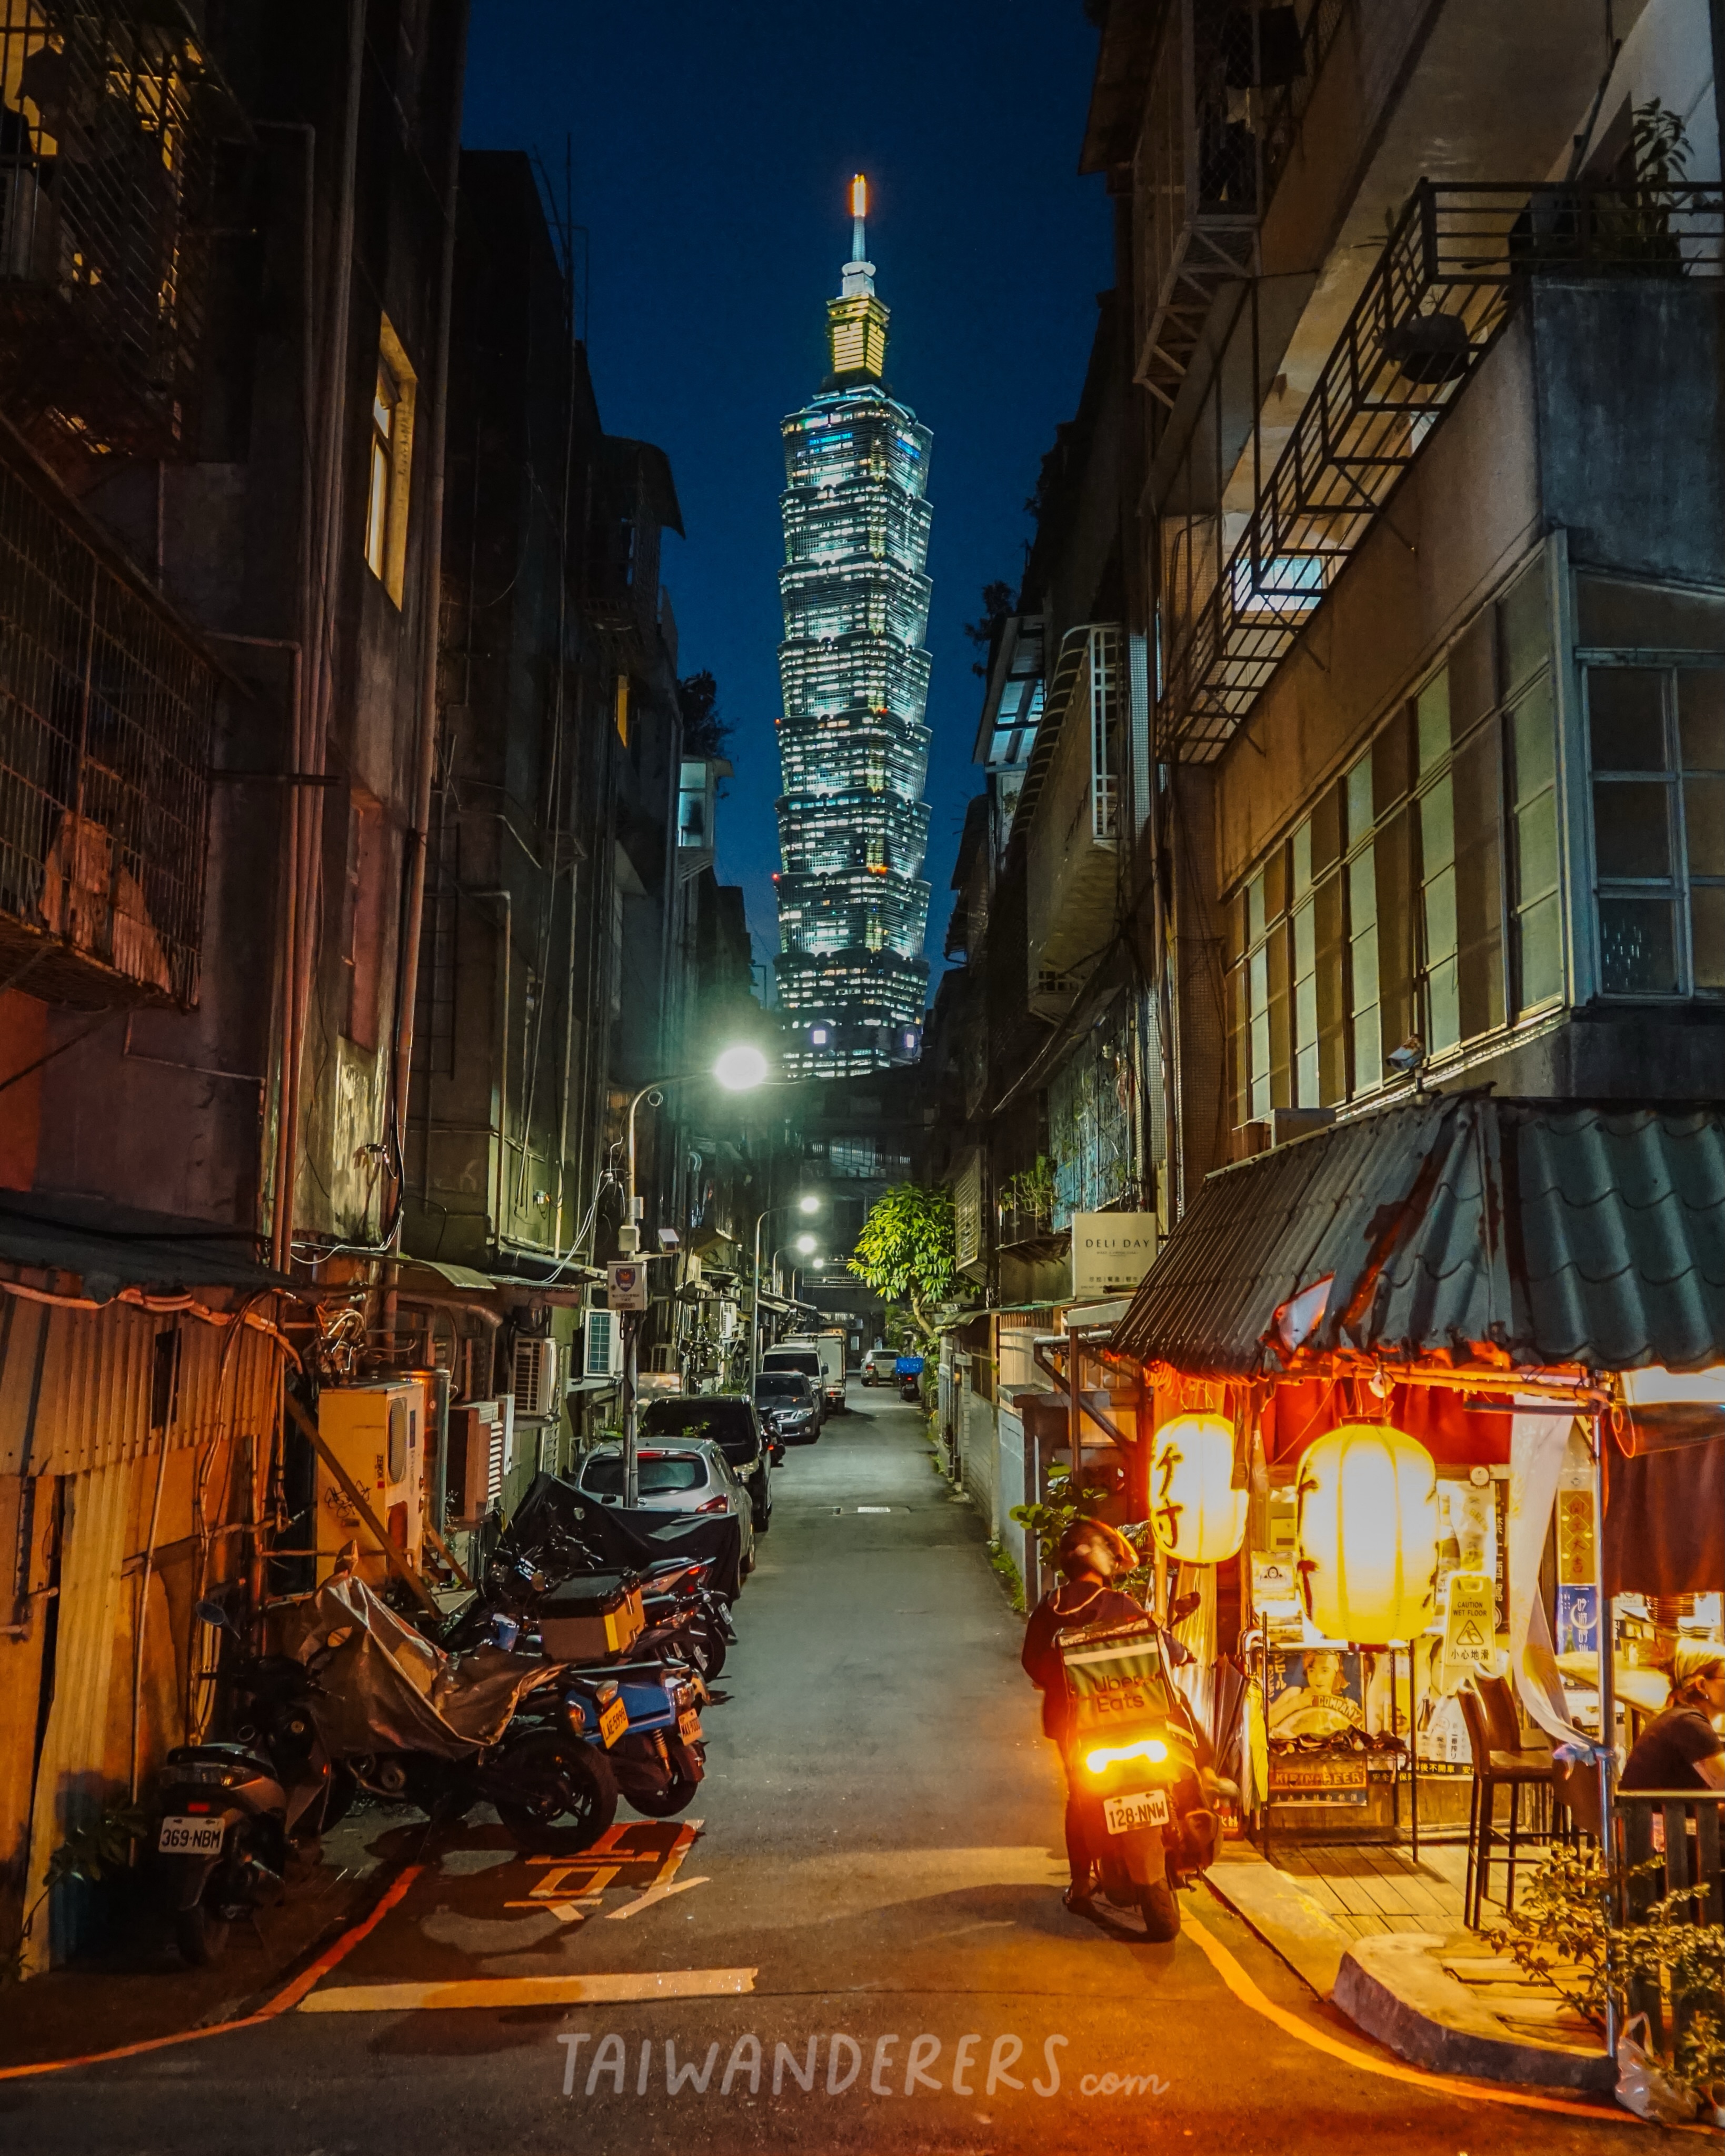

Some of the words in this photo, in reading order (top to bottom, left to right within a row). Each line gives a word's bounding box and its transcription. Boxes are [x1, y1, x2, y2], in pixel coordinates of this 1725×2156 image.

[1086, 1239, 1115, 1247] DELI
[1123, 1239, 1150, 1247] DAY
[1451, 1649, 1489, 1660] 小心地滑
[1093, 1675, 1141, 1693] Uber
[1097, 1693, 1144, 1713] Eats
[1318, 1696, 1362, 1721] COMPANY
